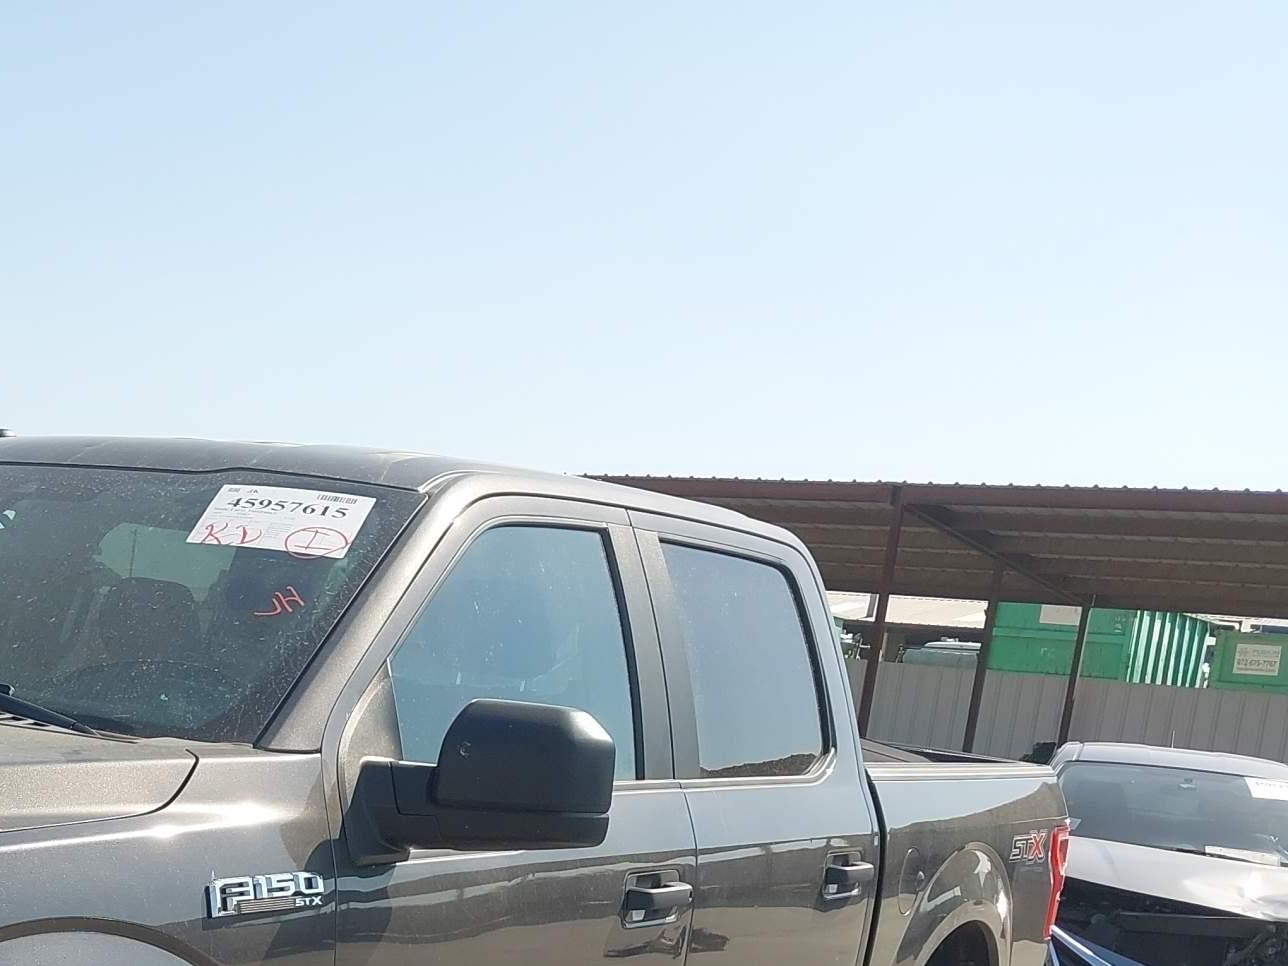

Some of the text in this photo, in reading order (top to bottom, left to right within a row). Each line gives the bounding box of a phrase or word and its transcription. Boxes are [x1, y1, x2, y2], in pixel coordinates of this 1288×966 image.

[227, 497, 350, 519] 45957615
[1009, 829, 1047, 864] STX
[295, 896, 323, 906] STX
